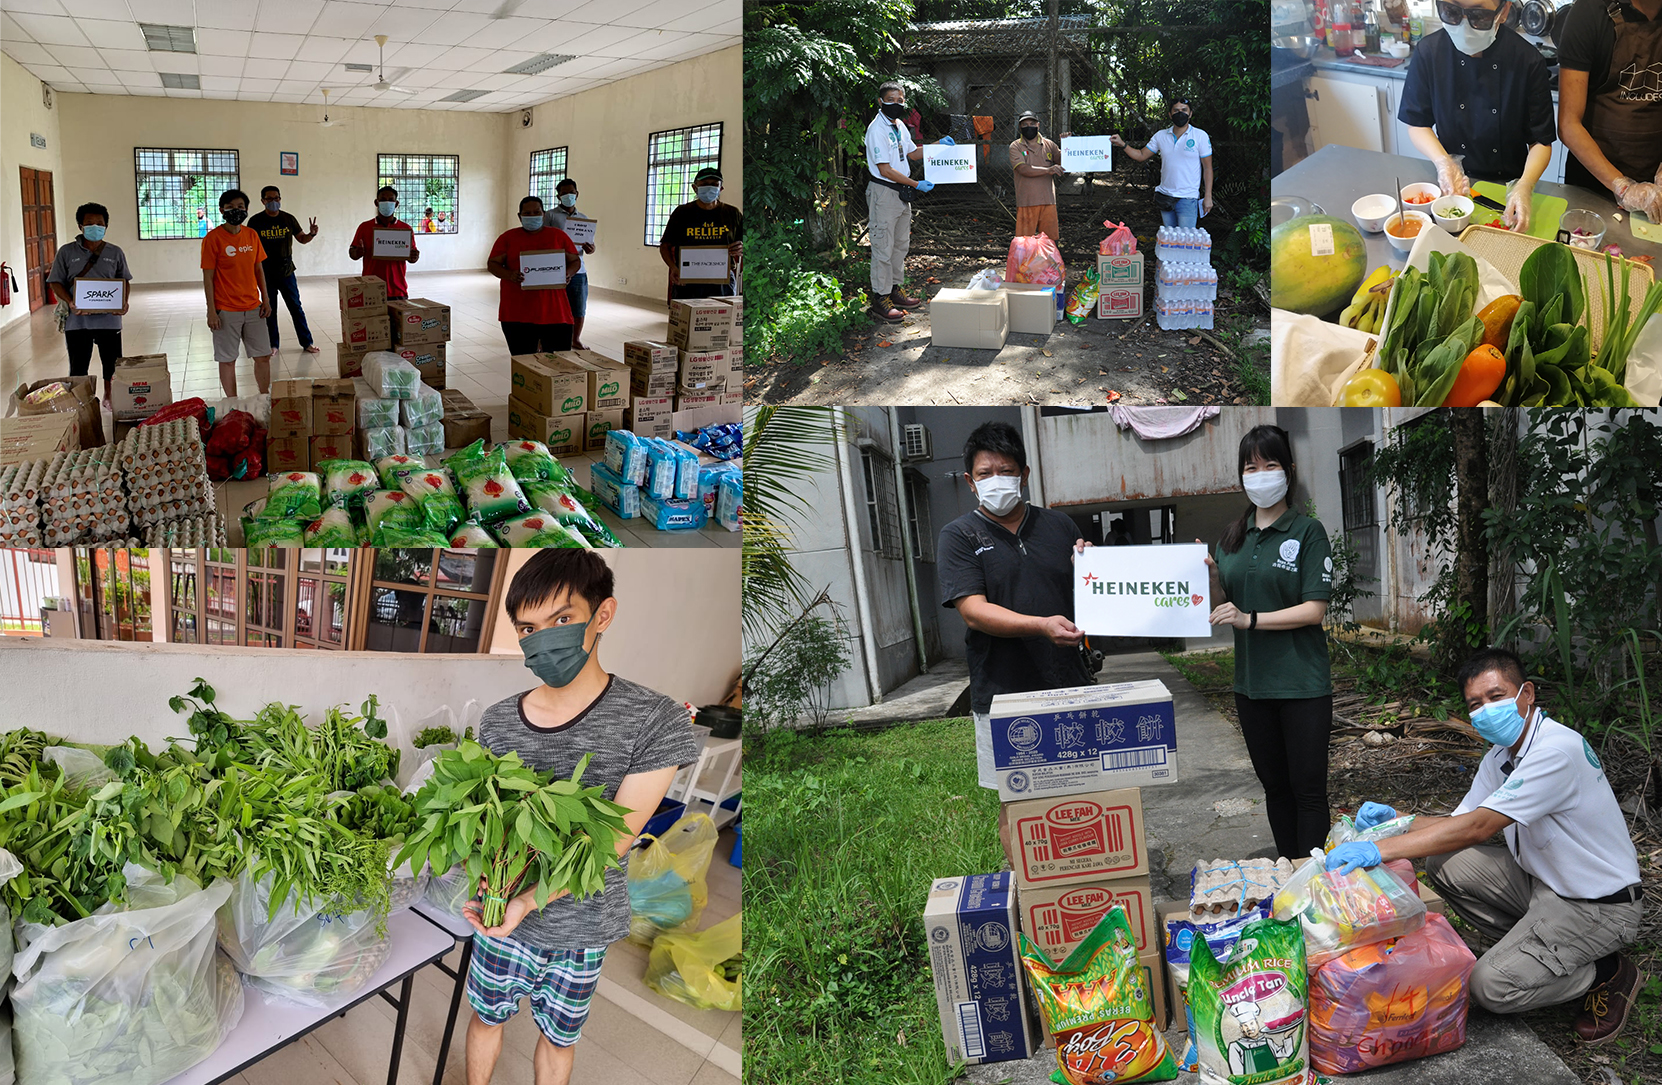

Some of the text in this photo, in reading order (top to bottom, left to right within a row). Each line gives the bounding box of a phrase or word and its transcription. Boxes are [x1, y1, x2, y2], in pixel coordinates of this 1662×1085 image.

[260, 229, 287, 237] RELIEF
[686, 227, 725, 237] RELIEF
[239, 245, 253, 253] epic
[83, 288, 118, 299] SPARK
[600, 384, 618, 394] MILO
[564, 400, 581, 410] MILO
[551, 431, 570, 441] MILO
[1092, 581, 1190, 595] HEINEKEN
[1154, 596, 1190, 608] cares
[1057, 750, 1078, 759] 428g
[1087, 748, 1098, 756] 12
[1055, 806, 1094, 820] LEE FAH
[1067, 892, 1104, 906] LEE FAH
[1263, 958, 1293, 968] RICE
[1221, 977, 1283, 1004] Uncle Tan
[1056, 1006, 1131, 1030] BERAS PREMIUM
[1063, 1021, 1116, 1054] Boy
